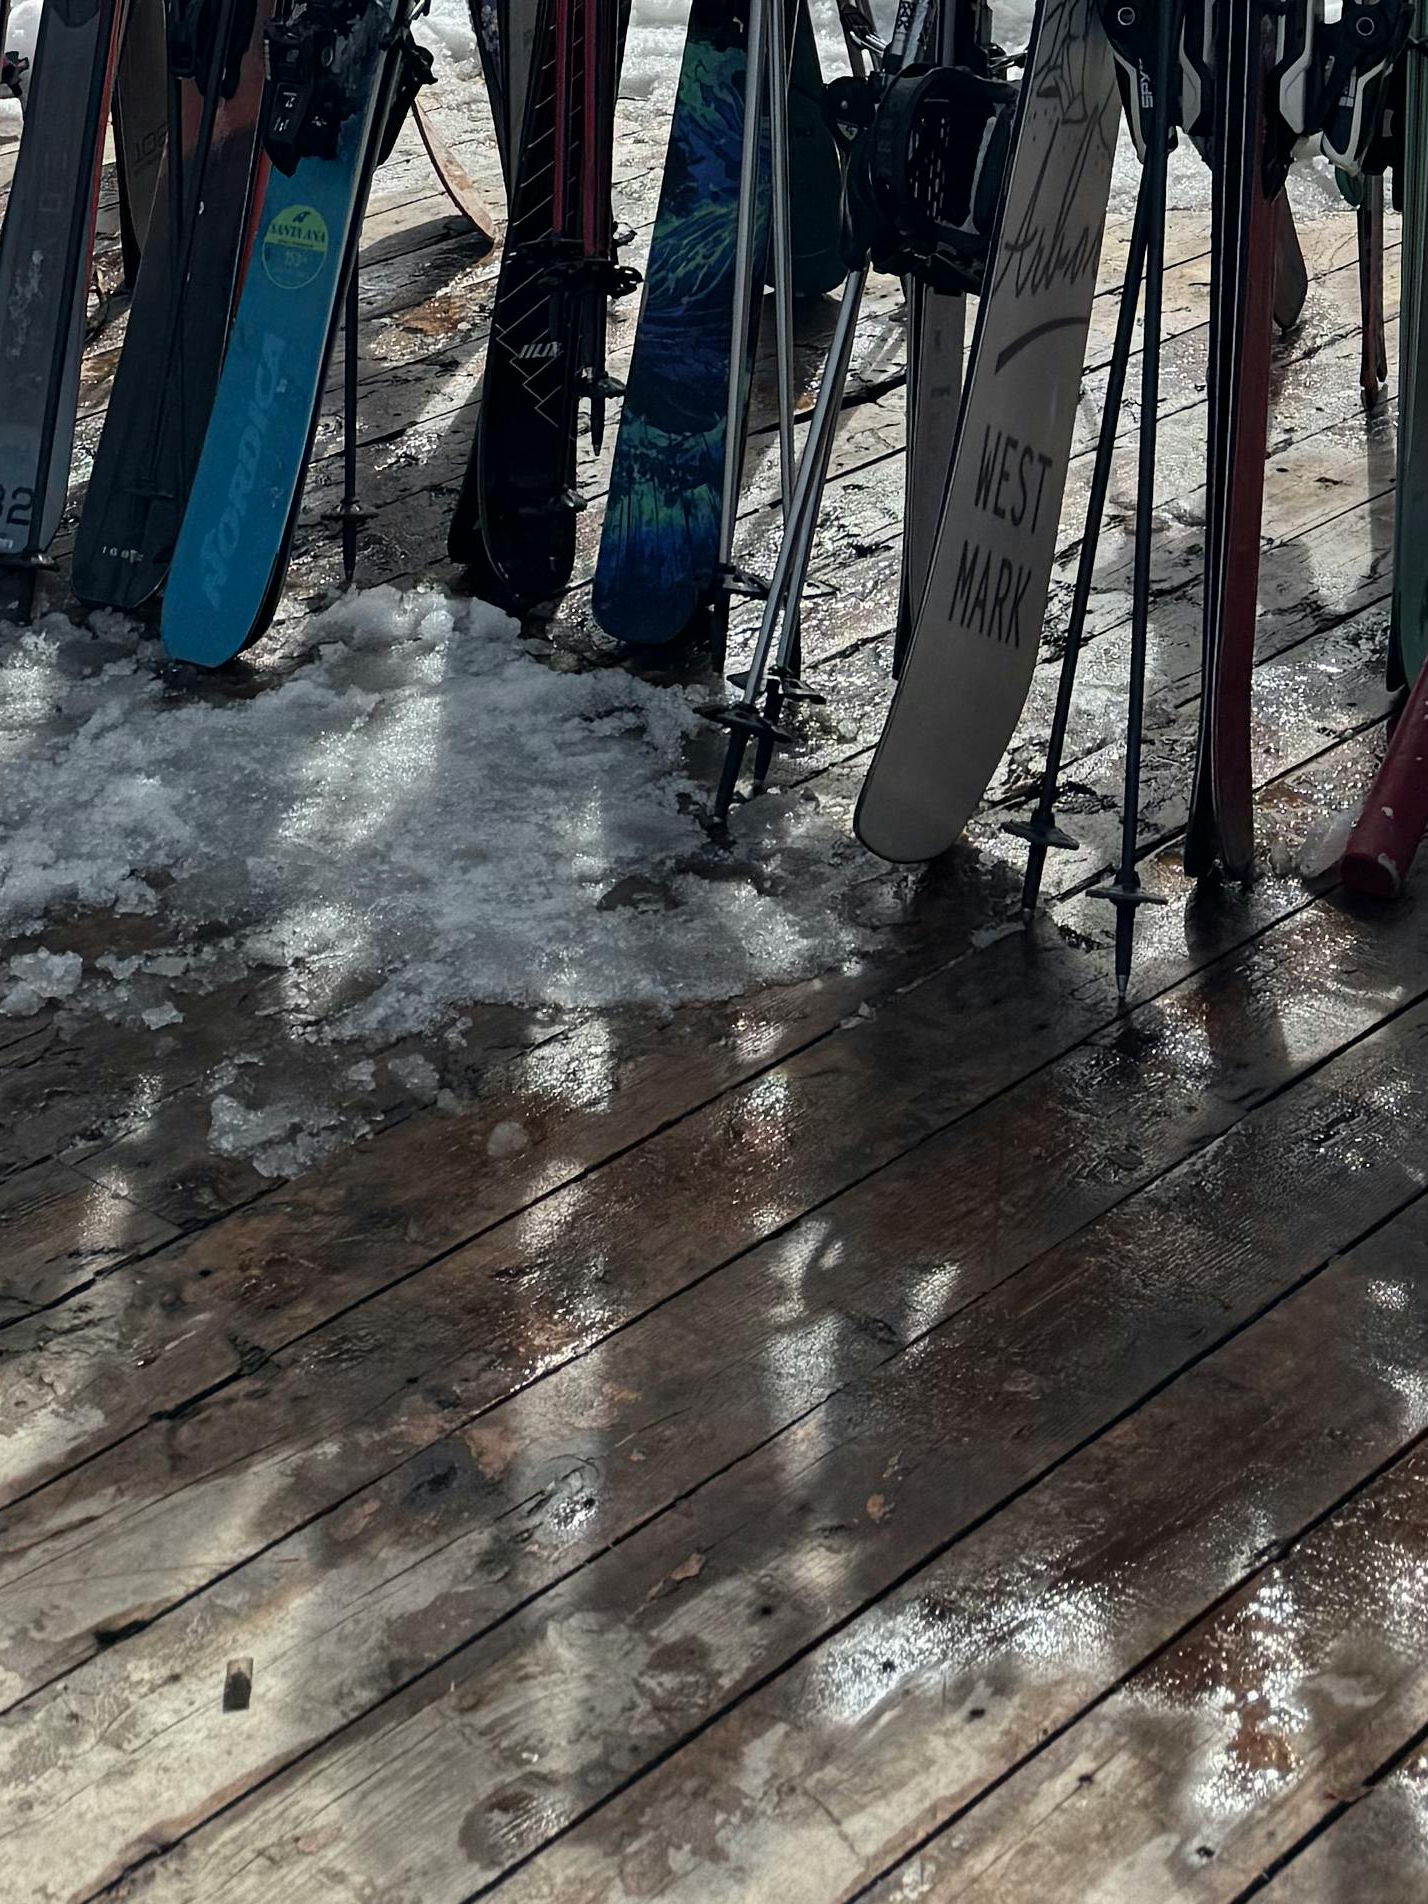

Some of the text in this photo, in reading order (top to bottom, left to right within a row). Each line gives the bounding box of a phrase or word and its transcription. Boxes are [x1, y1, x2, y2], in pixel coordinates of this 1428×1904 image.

[201, 332, 286, 611] NORDICA
[974, 423, 1053, 535] WEST
[948, 538, 1032, 649] MARK
